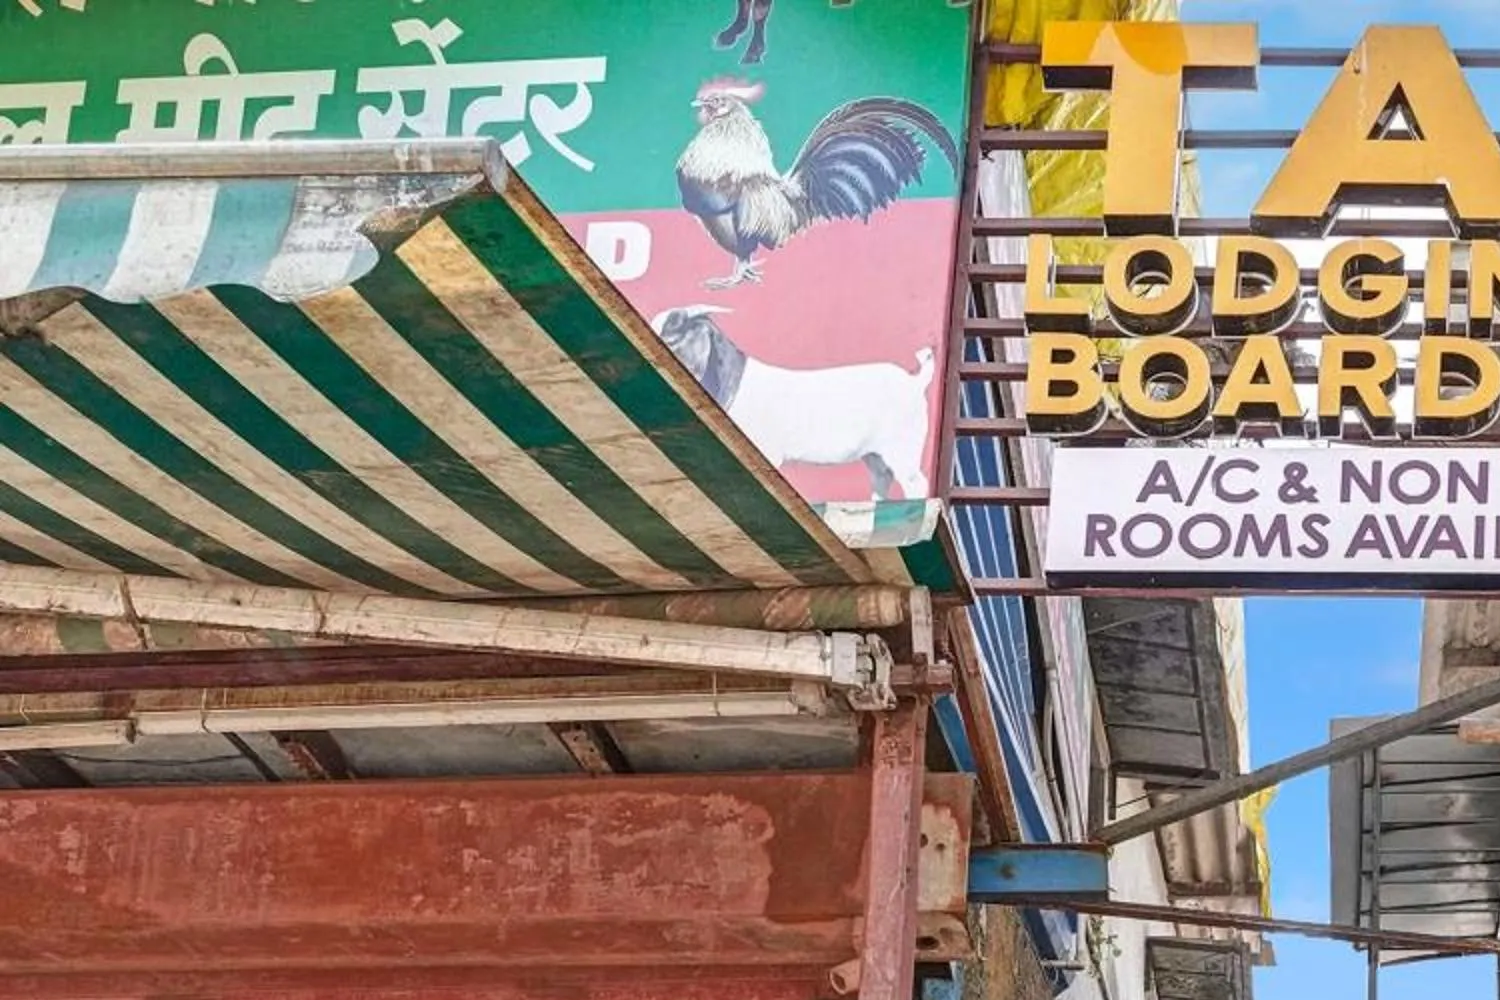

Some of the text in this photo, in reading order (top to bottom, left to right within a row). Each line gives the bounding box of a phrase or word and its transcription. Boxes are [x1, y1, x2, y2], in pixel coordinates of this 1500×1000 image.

[1136, 455, 1260, 507] A/C
[1278, 461, 1319, 503] &
[1340, 460, 1490, 504] NON
[1083, 513, 1331, 559] ROOMS
